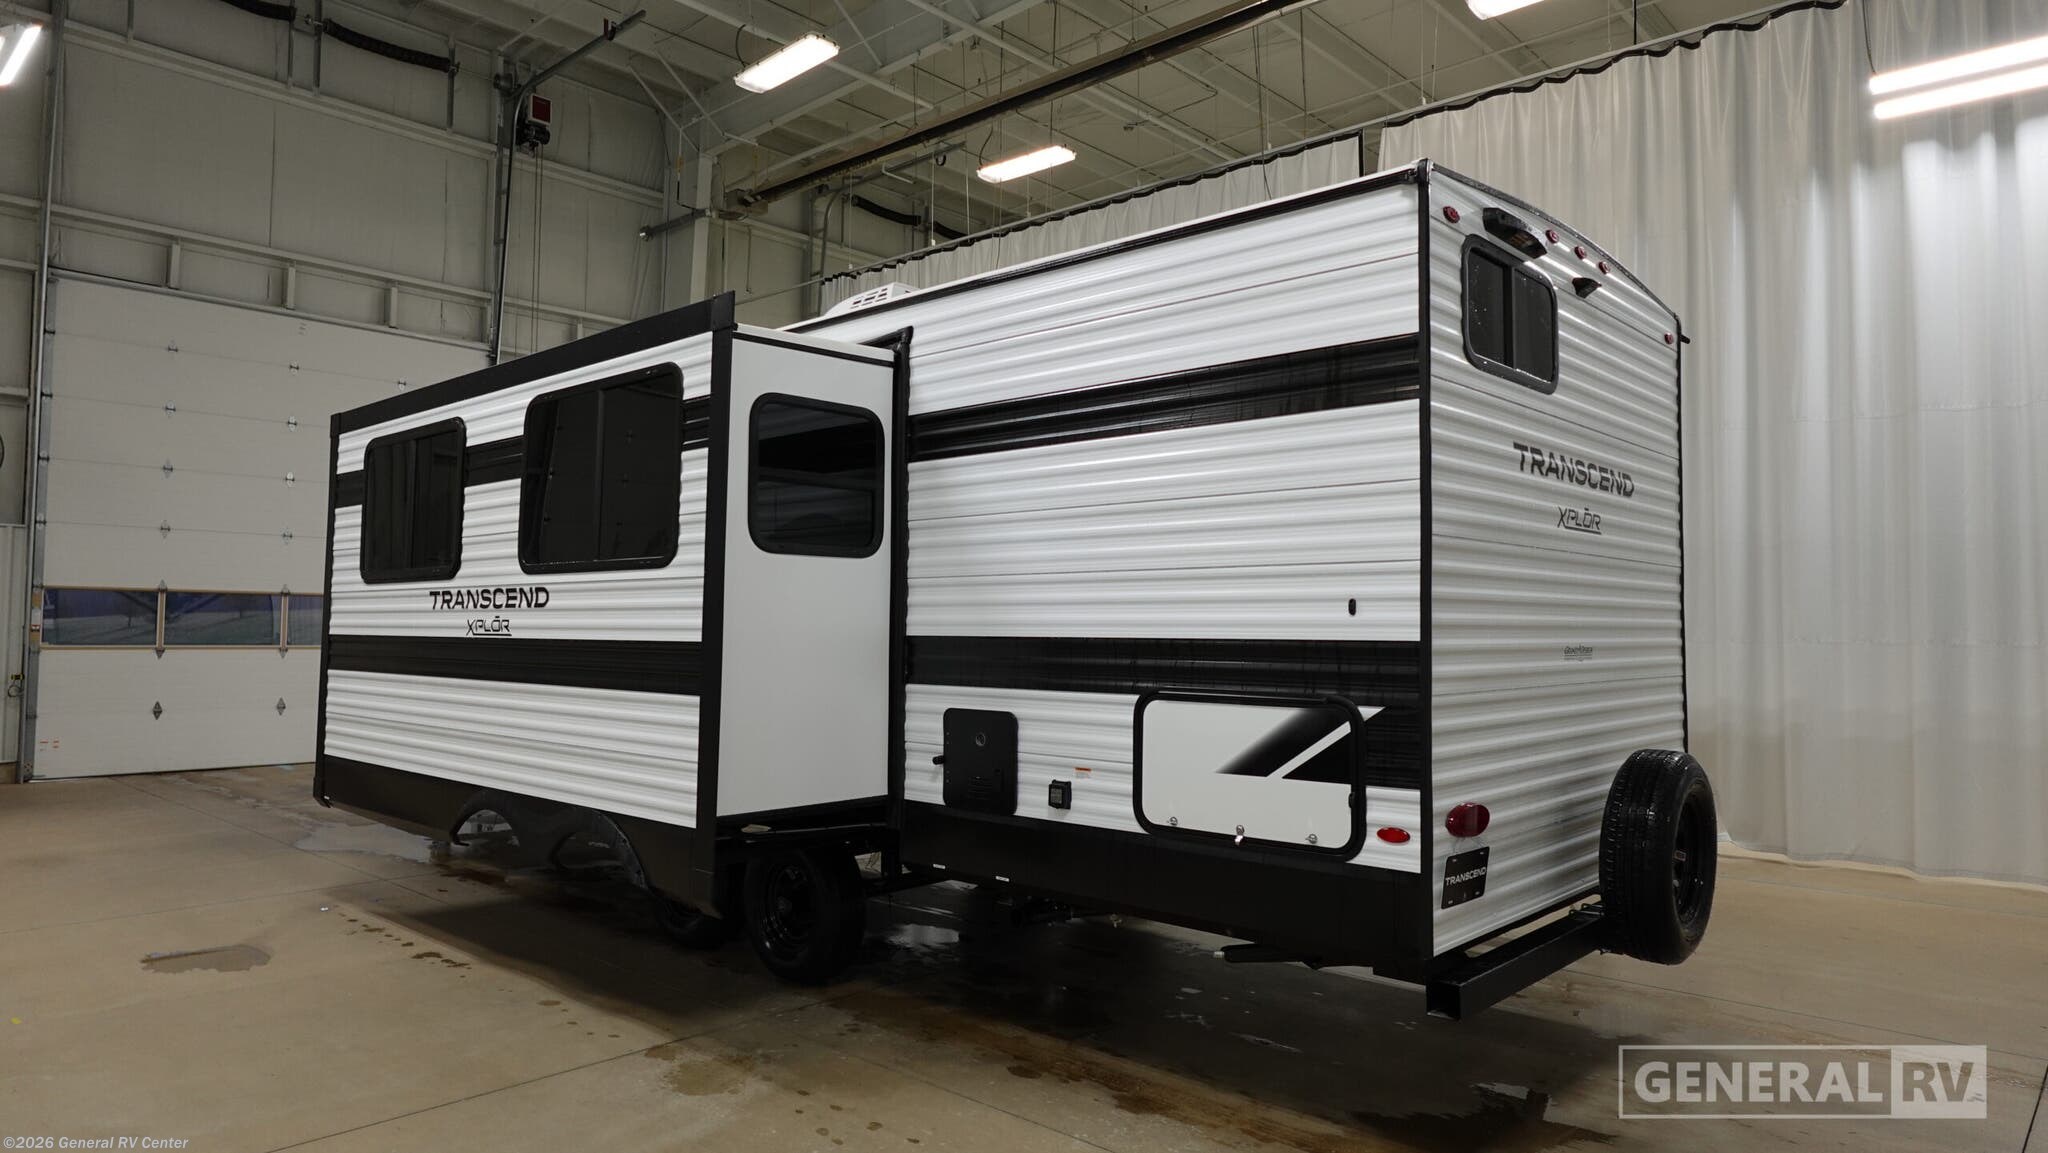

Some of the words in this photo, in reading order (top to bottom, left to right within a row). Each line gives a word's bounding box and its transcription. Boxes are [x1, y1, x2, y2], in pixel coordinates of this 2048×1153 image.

[1513, 441, 1635, 497] TRANSCEND
[429, 586, 550, 610] TRANSCEND
[1445, 866, 1487, 886] TRANSCEND
